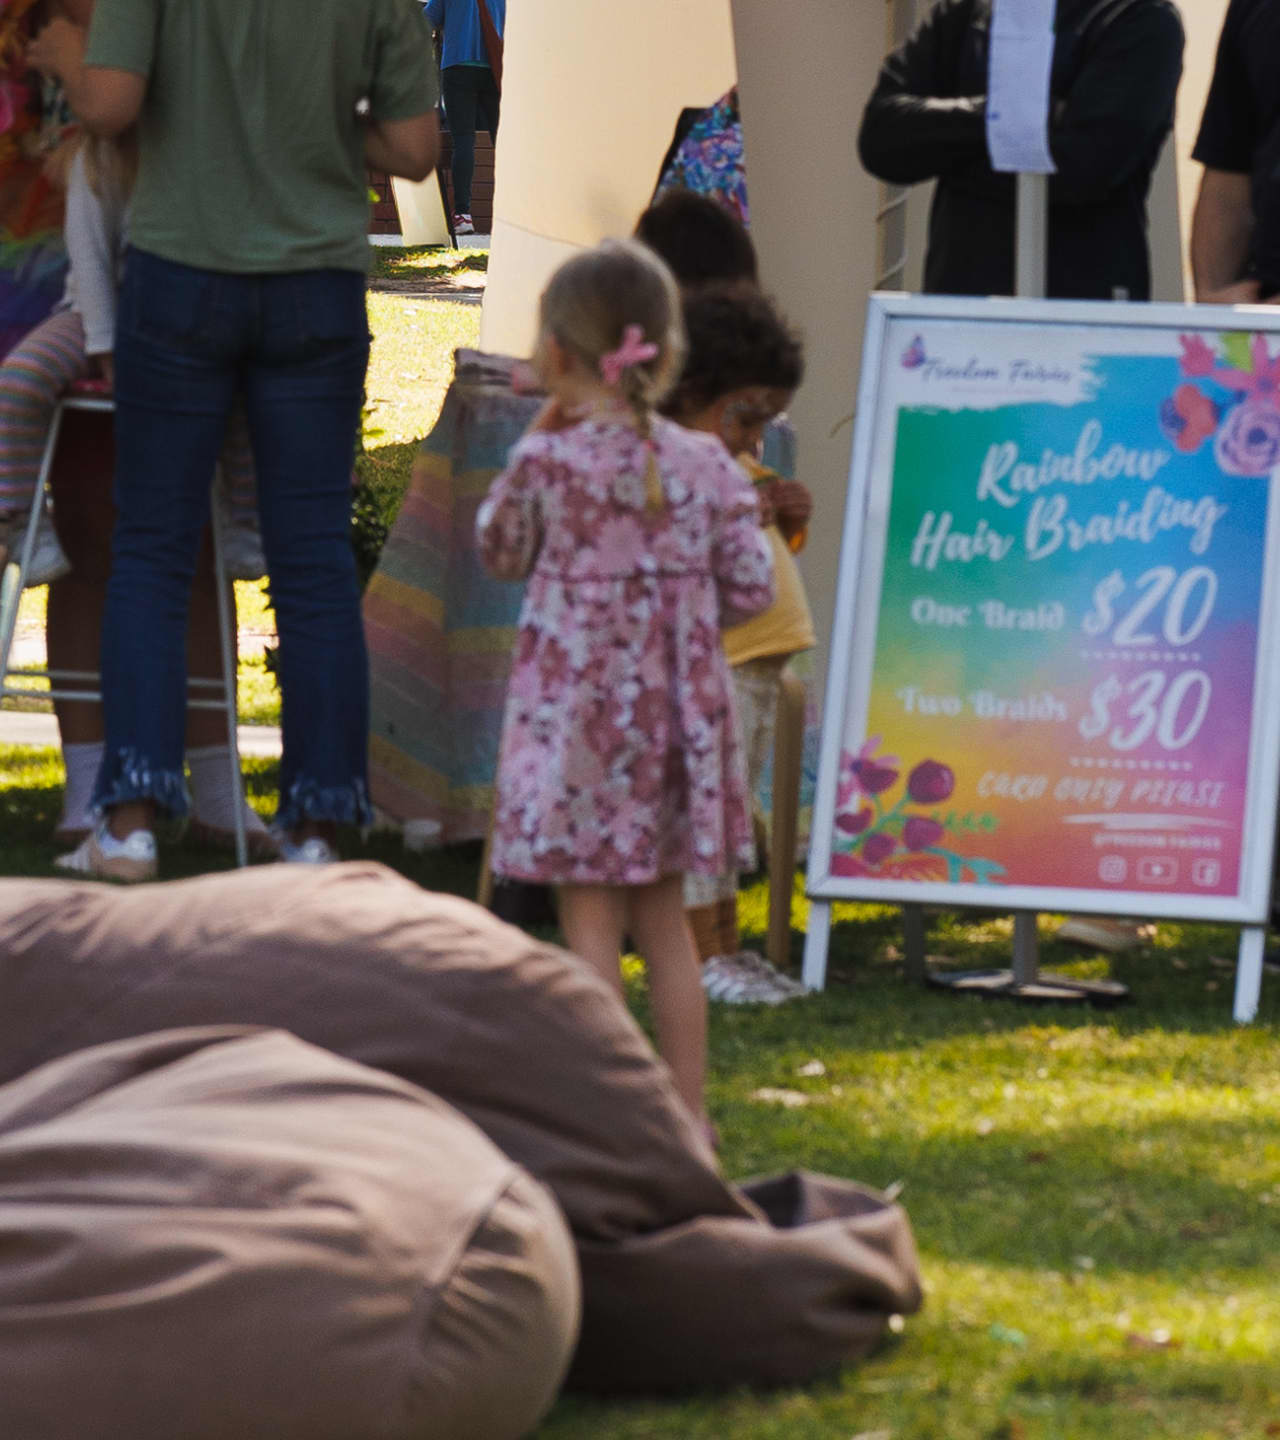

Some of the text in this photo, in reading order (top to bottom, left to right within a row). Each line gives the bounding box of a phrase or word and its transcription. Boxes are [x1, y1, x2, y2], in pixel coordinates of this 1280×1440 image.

[976, 418, 1171, 508] Rainbow
[910, 485, 1228, 572] Hair Braiding
[910, 565, 1219, 648] One Braid $20
[896, 669, 1212, 752] Two Braids $30
